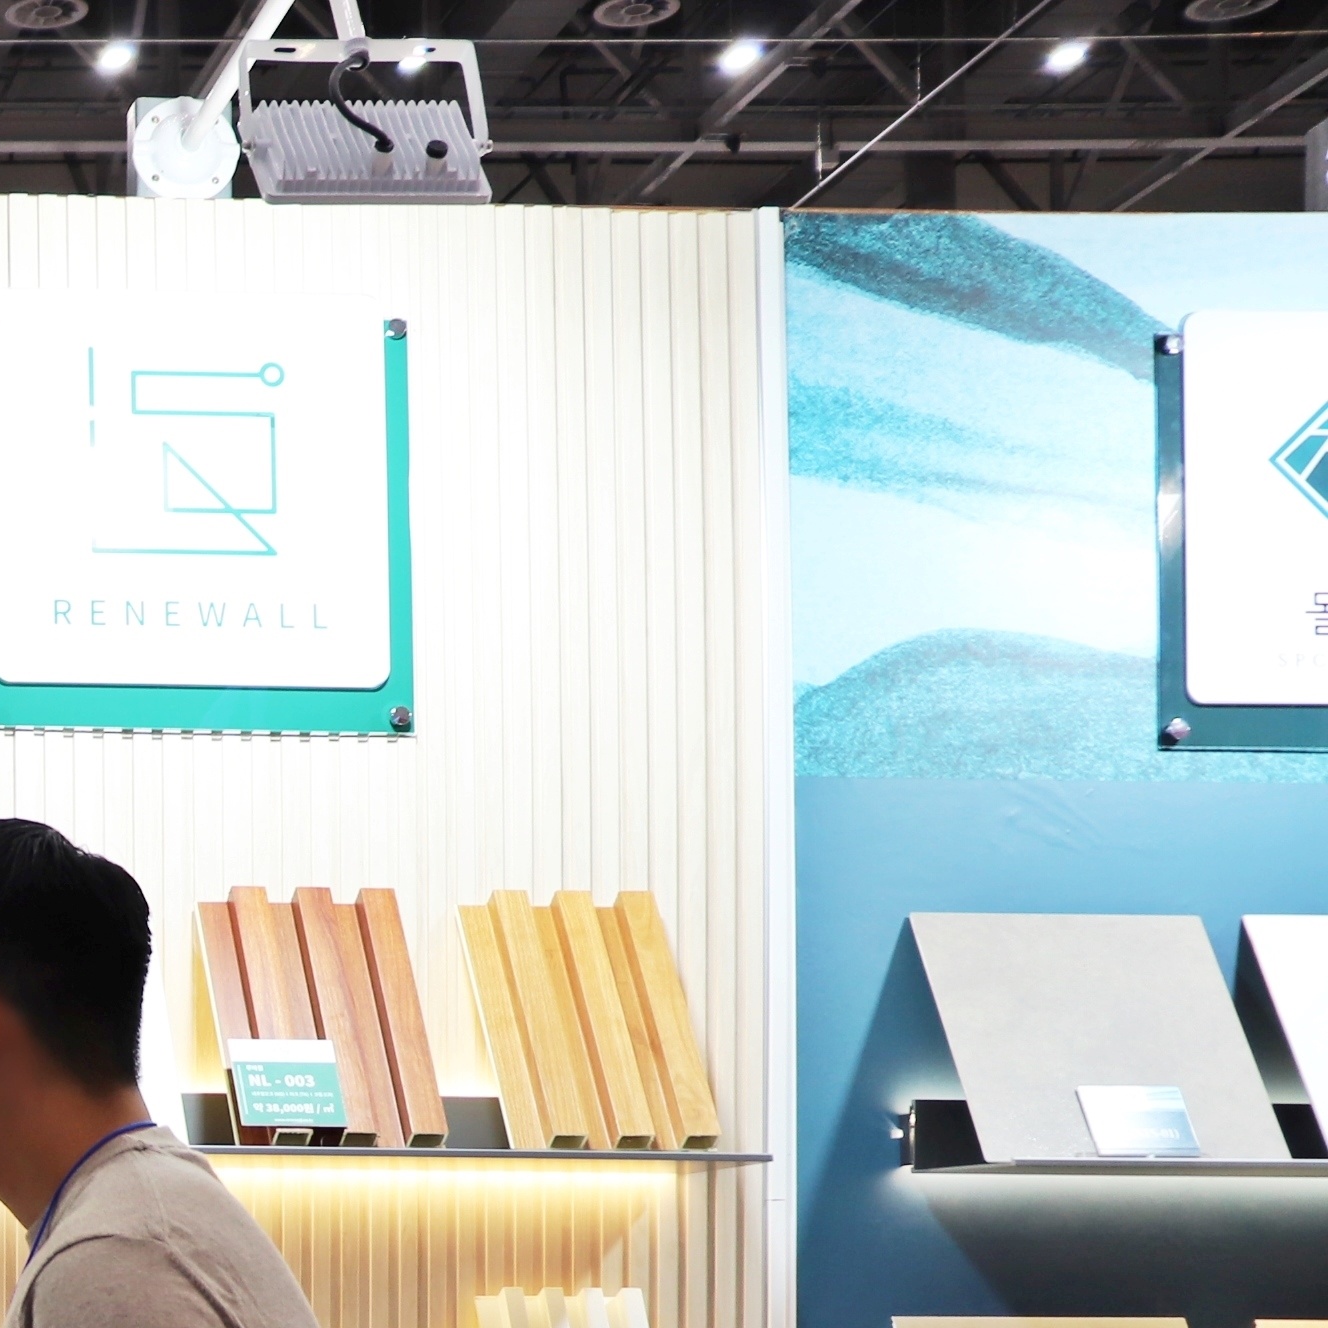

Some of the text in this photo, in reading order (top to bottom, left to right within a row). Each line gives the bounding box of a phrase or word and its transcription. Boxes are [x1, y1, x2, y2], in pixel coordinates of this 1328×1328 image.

[53, 599, 329, 630] RENEWALL
[247, 1074, 272, 1087] NL
[284, 1074, 316, 1088] 003
